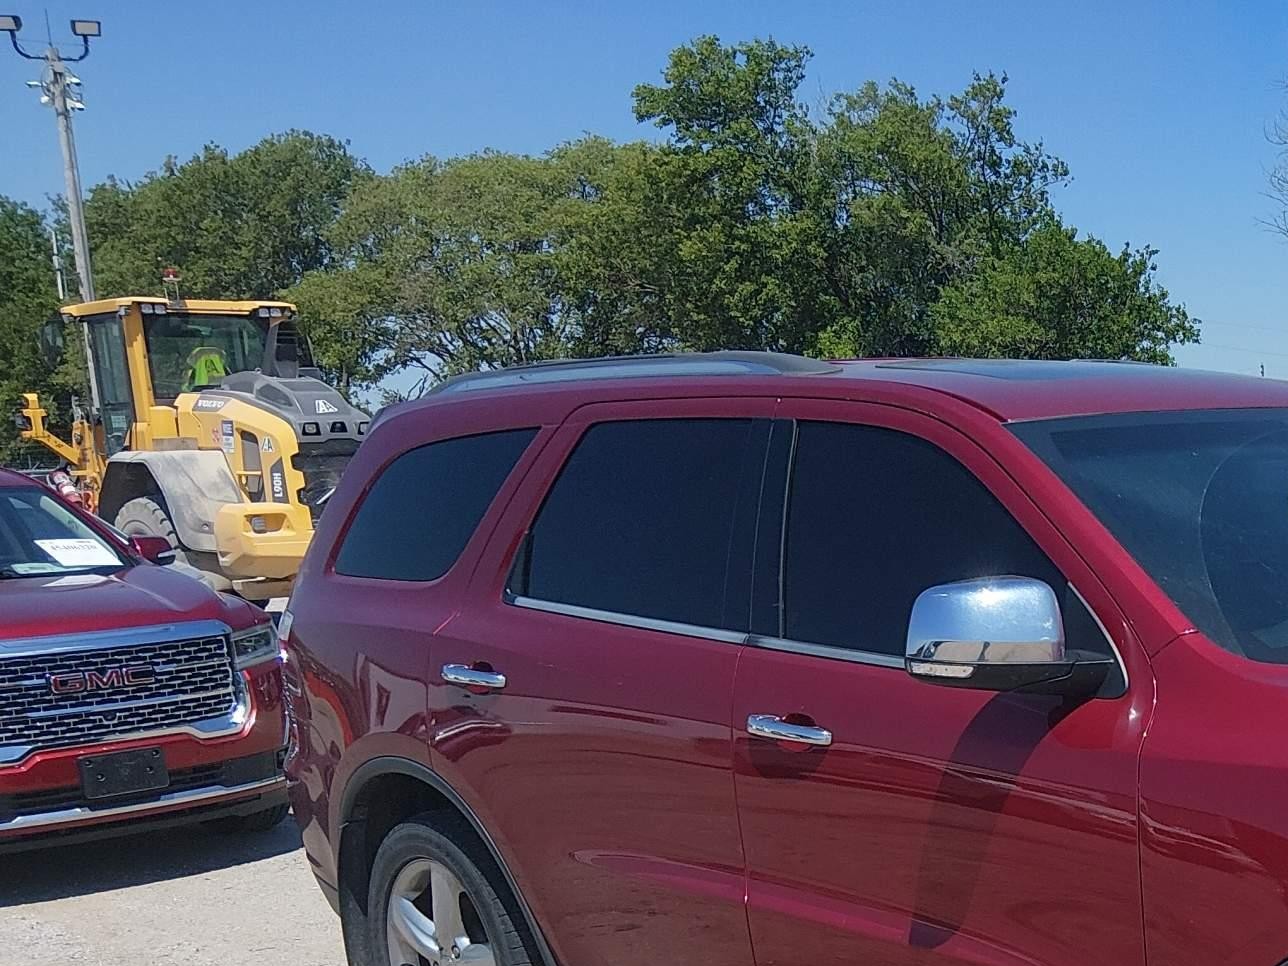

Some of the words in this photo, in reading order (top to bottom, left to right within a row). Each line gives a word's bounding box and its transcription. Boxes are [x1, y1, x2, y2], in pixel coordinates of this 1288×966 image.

[197, 399, 225, 409] VOLVO
[272, 472, 284, 498] L90H
[50, 665, 156, 695] GMC
